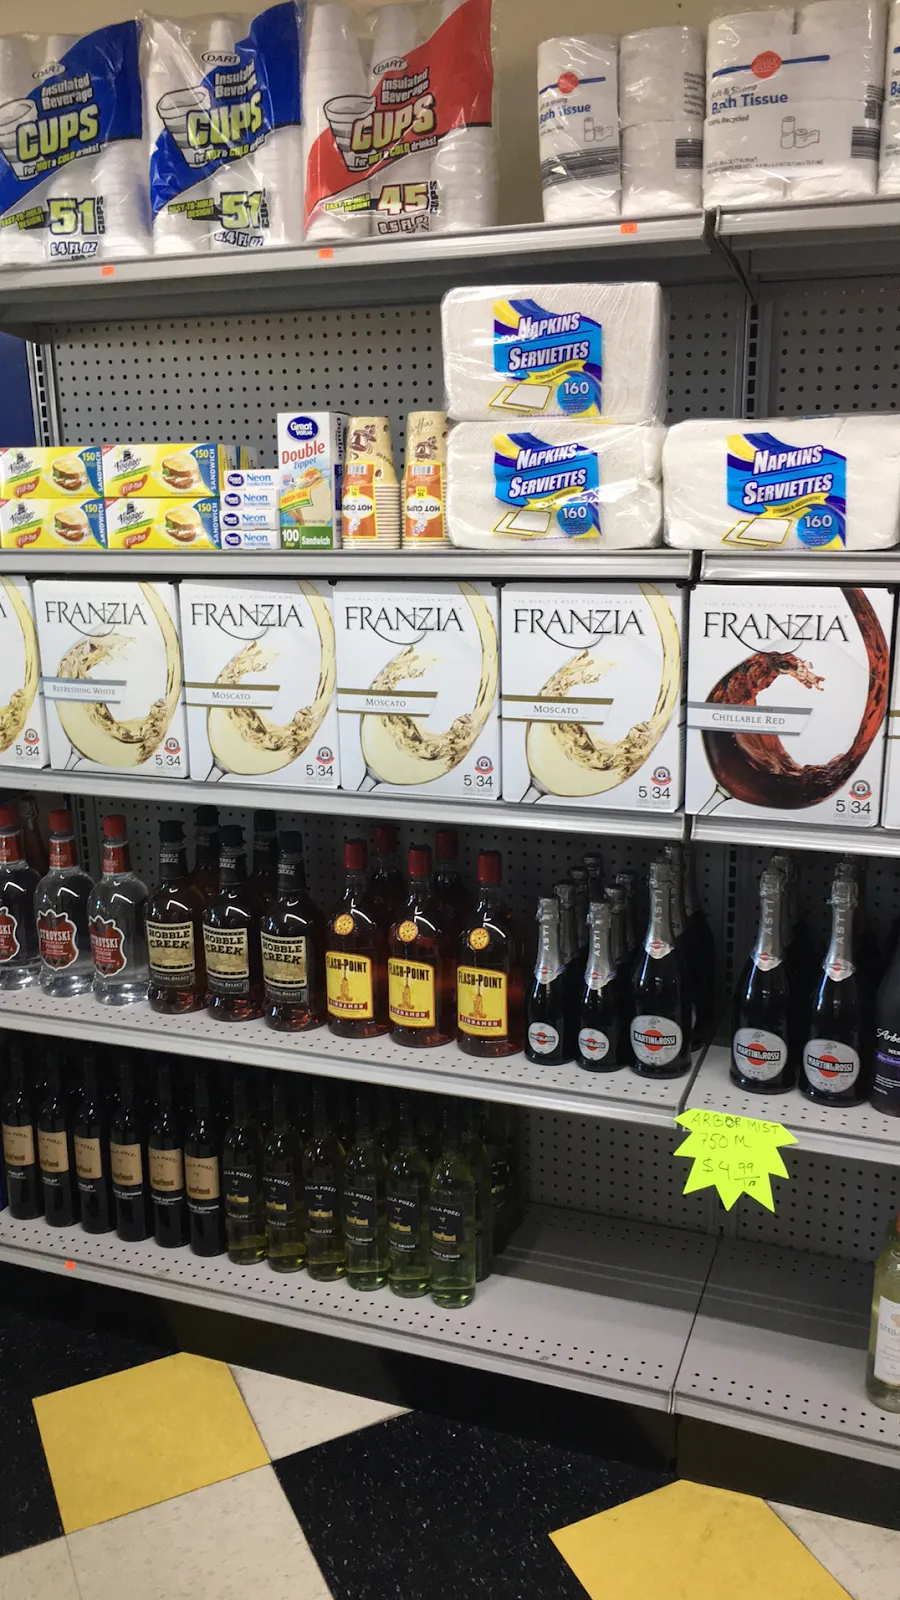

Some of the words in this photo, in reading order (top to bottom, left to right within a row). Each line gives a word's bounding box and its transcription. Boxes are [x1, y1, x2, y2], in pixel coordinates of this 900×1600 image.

[206, 53, 238, 64] DART
[376, 60, 404, 74] DART
[42, 73, 91, 97] Insulated
[382, 67, 429, 92] Insulated
[42, 86, 93, 111] Beverage
[382, 80, 429, 105] Beverage
[559, 104, 591, 117] Tissue
[712, 97, 736, 115] Bath
[741, 93, 788, 107] Tissue
[187, 92, 263, 147] CUPS
[351, 93, 437, 153] CUPS
[722, 115, 749, 124] Recycled
[17, 104, 100, 163] CUPS
[411, 135, 438, 152] drinks!
[377, 182, 429, 216] 45
[47, 197, 97, 235] 51
[219, 191, 262, 230] 51
[378, 221, 399, 235] 8.5
[236, 232, 250, 247] FL
[68, 242, 81, 254] FL
[519, 312, 581, 340] NAPKINS
[508, 341, 590, 371] SERVIETTES
[564, 382, 589, 395] 160
[290, 422, 313, 432] Great
[82, 452, 96, 461] 150
[194, 449, 208, 459] 150
[281, 440, 326, 465] Double
[517, 443, 578, 470] NAPKINS
[293, 457, 317, 471] Zipper
[753, 445, 823, 475] NAPKINS
[246, 473, 271, 482] Neon
[508, 469, 587, 498] SERVIETTES
[742, 474, 833, 506] SERVIETTES
[243, 494, 268, 502] Neon
[84, 504, 98, 513] 150
[198, 503, 212, 513] 150
[562, 507, 587, 519] 160
[242, 514, 266, 522] Neon
[804, 515, 833, 528] 160
[243, 534, 268, 542] Neon
[282, 529, 299, 541] 100
[301, 535, 331, 546] Sandwich
[45, 601, 148, 632] FRANZIA
[191, 603, 305, 634] FRANZIA
[345, 606, 465, 638] FRANZIA
[513, 608, 646, 642] FRANZIA
[703, 612, 849, 648] FRANZIA
[52, 684, 91, 694] REFRESHING
[92, 687, 116, 696] WHITE
[212, 691, 251, 701] MOSCATO
[366, 698, 406, 708] MOSCATO
[533, 704, 579, 715] MOSCATO
[712, 712, 762, 725] CHILLABLE
[765, 715, 786, 726] RED
[16, 745, 23, 755] 5
[26, 746, 40, 756] 34
[156, 755, 163, 766] 5
[167, 755, 181, 766] 34
[306, 765, 315, 776] 5
[318, 765, 334, 777] 34
[464, 775, 472, 787] 5
[476, 776, 493, 788] 34
[639, 786, 647, 798] 5
[652, 787, 671, 799] 34
[836, 800, 846, 813] 5
[851, 801, 871, 814] 34
[836, 908, 845, 944] ASTI
[149, 929, 190, 939] HOBBLE
[204, 934, 244, 945] HOBBLE
[542, 925, 550, 952] ASTI
[149, 939, 190, 950] CREEK
[206, 944, 244, 956] CREEK
[262, 942, 302, 953] HOBBLE
[593, 930, 601, 957] ASTI
[264, 952, 302, 965] CREEK
[326, 956, 367, 974] FLASH-POINT
[389, 962, 430, 982] FLASH-POINT
[458, 971, 502, 989] FLASH-POINT
[329, 999, 364, 1010] CINNAMON
[391, 1007, 426, 1018] CINNAMON
[461, 1016, 498, 1027] CINNAMON
[691, 1113, 741, 1128] ARBOR
[747, 1121, 780, 1135] MIST
[699, 1133, 729, 1149] 750
